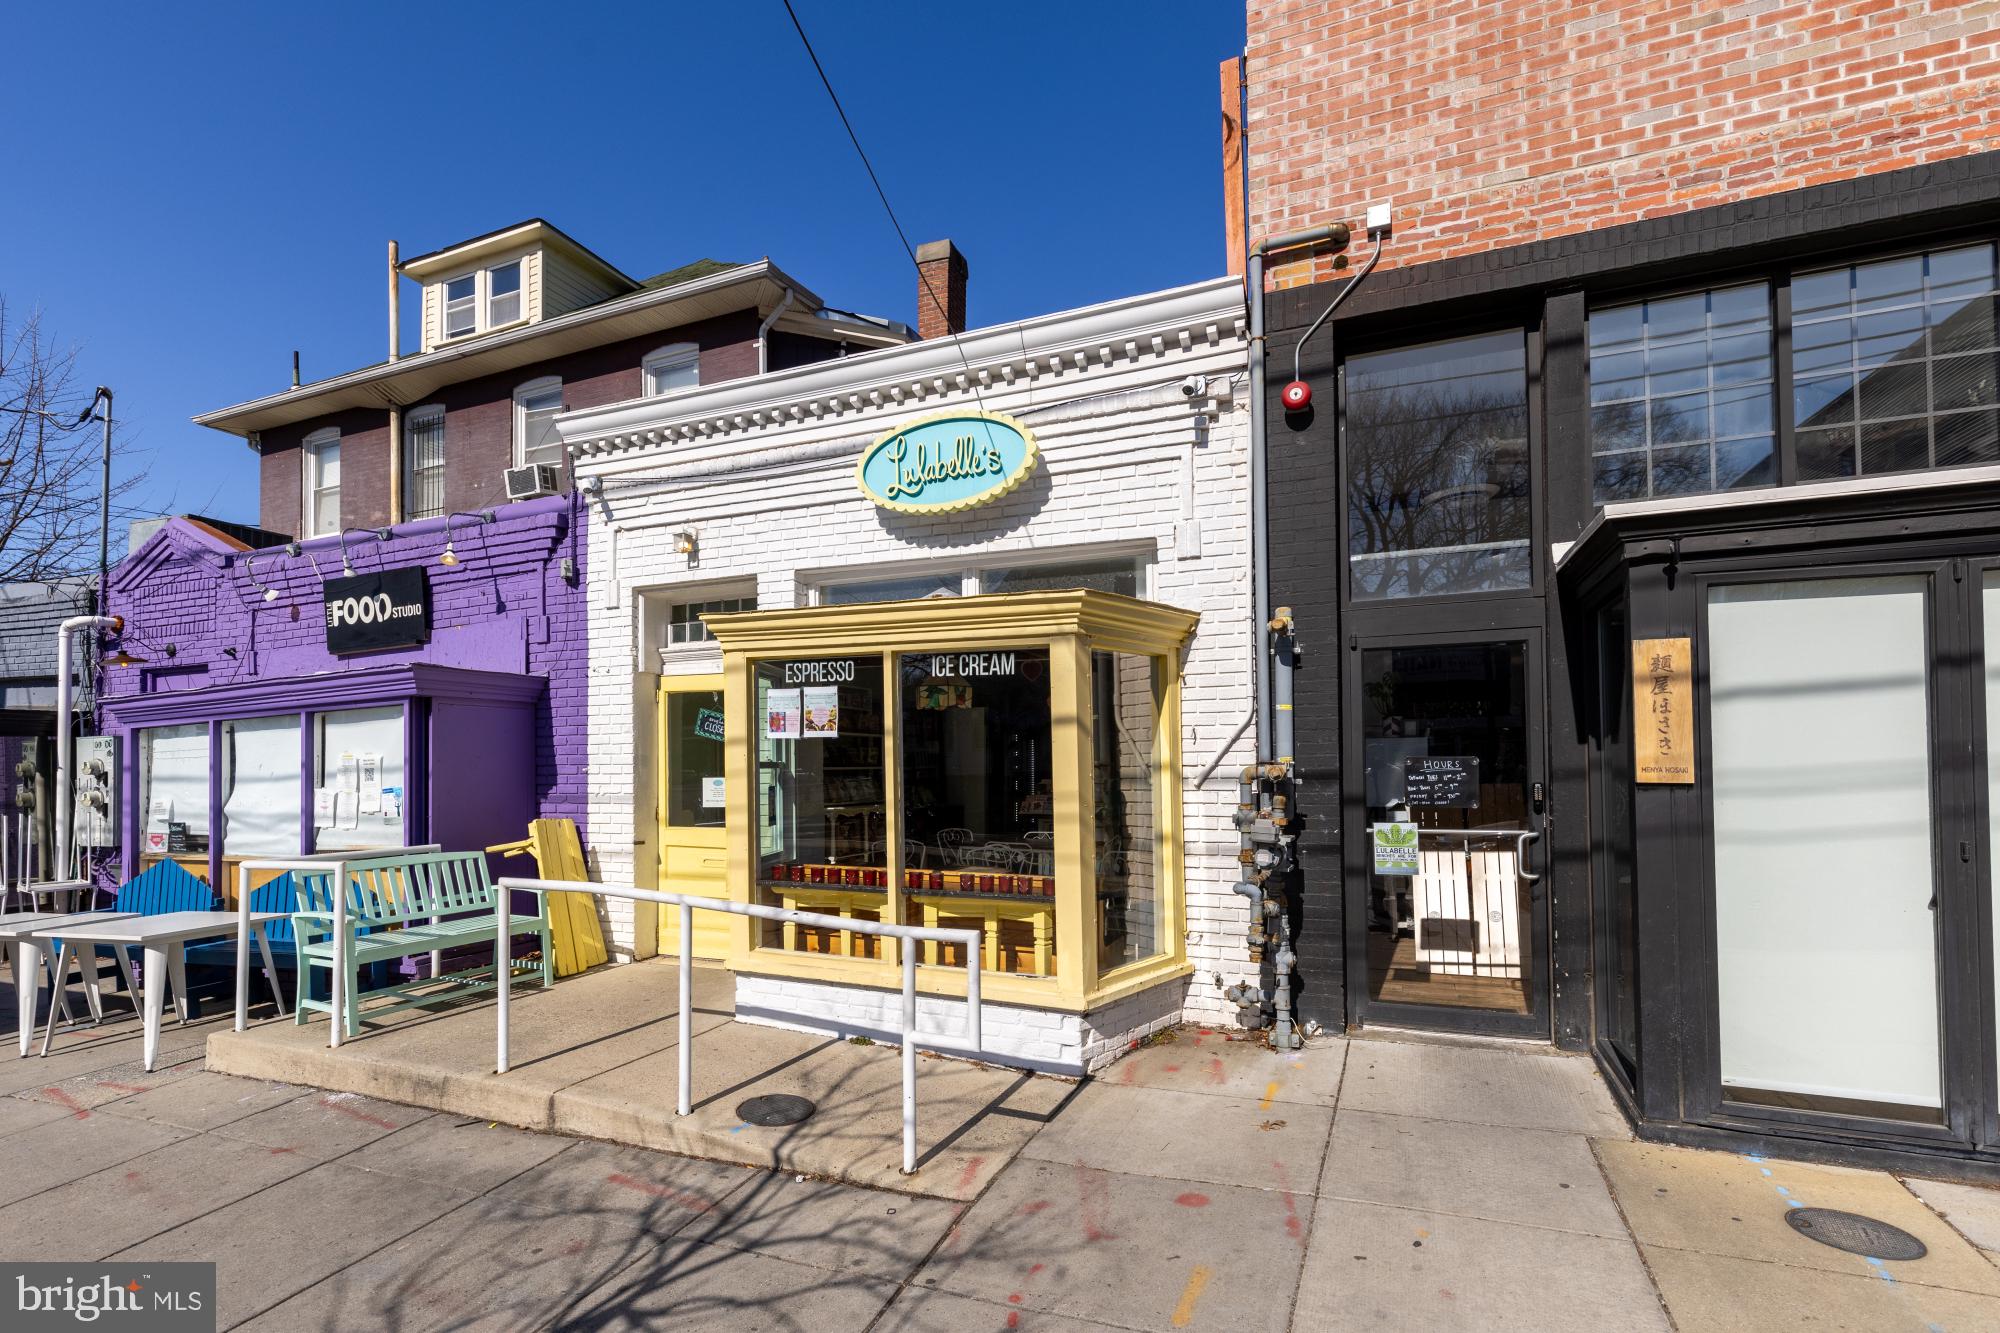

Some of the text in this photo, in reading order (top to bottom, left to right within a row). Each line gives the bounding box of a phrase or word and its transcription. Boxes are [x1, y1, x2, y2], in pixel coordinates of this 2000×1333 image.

[886, 435, 1001, 500] Lulabelle's
[332, 593, 421, 626] FOOD STUDIO
[785, 660, 854, 683] ESPRESSO
[931, 653, 1015, 677] ICE CREAM
[704, 721, 724, 735] CLOSE
[1423, 759, 1460, 769] HOURS
[1376, 847, 1417, 855] LULABELLE
